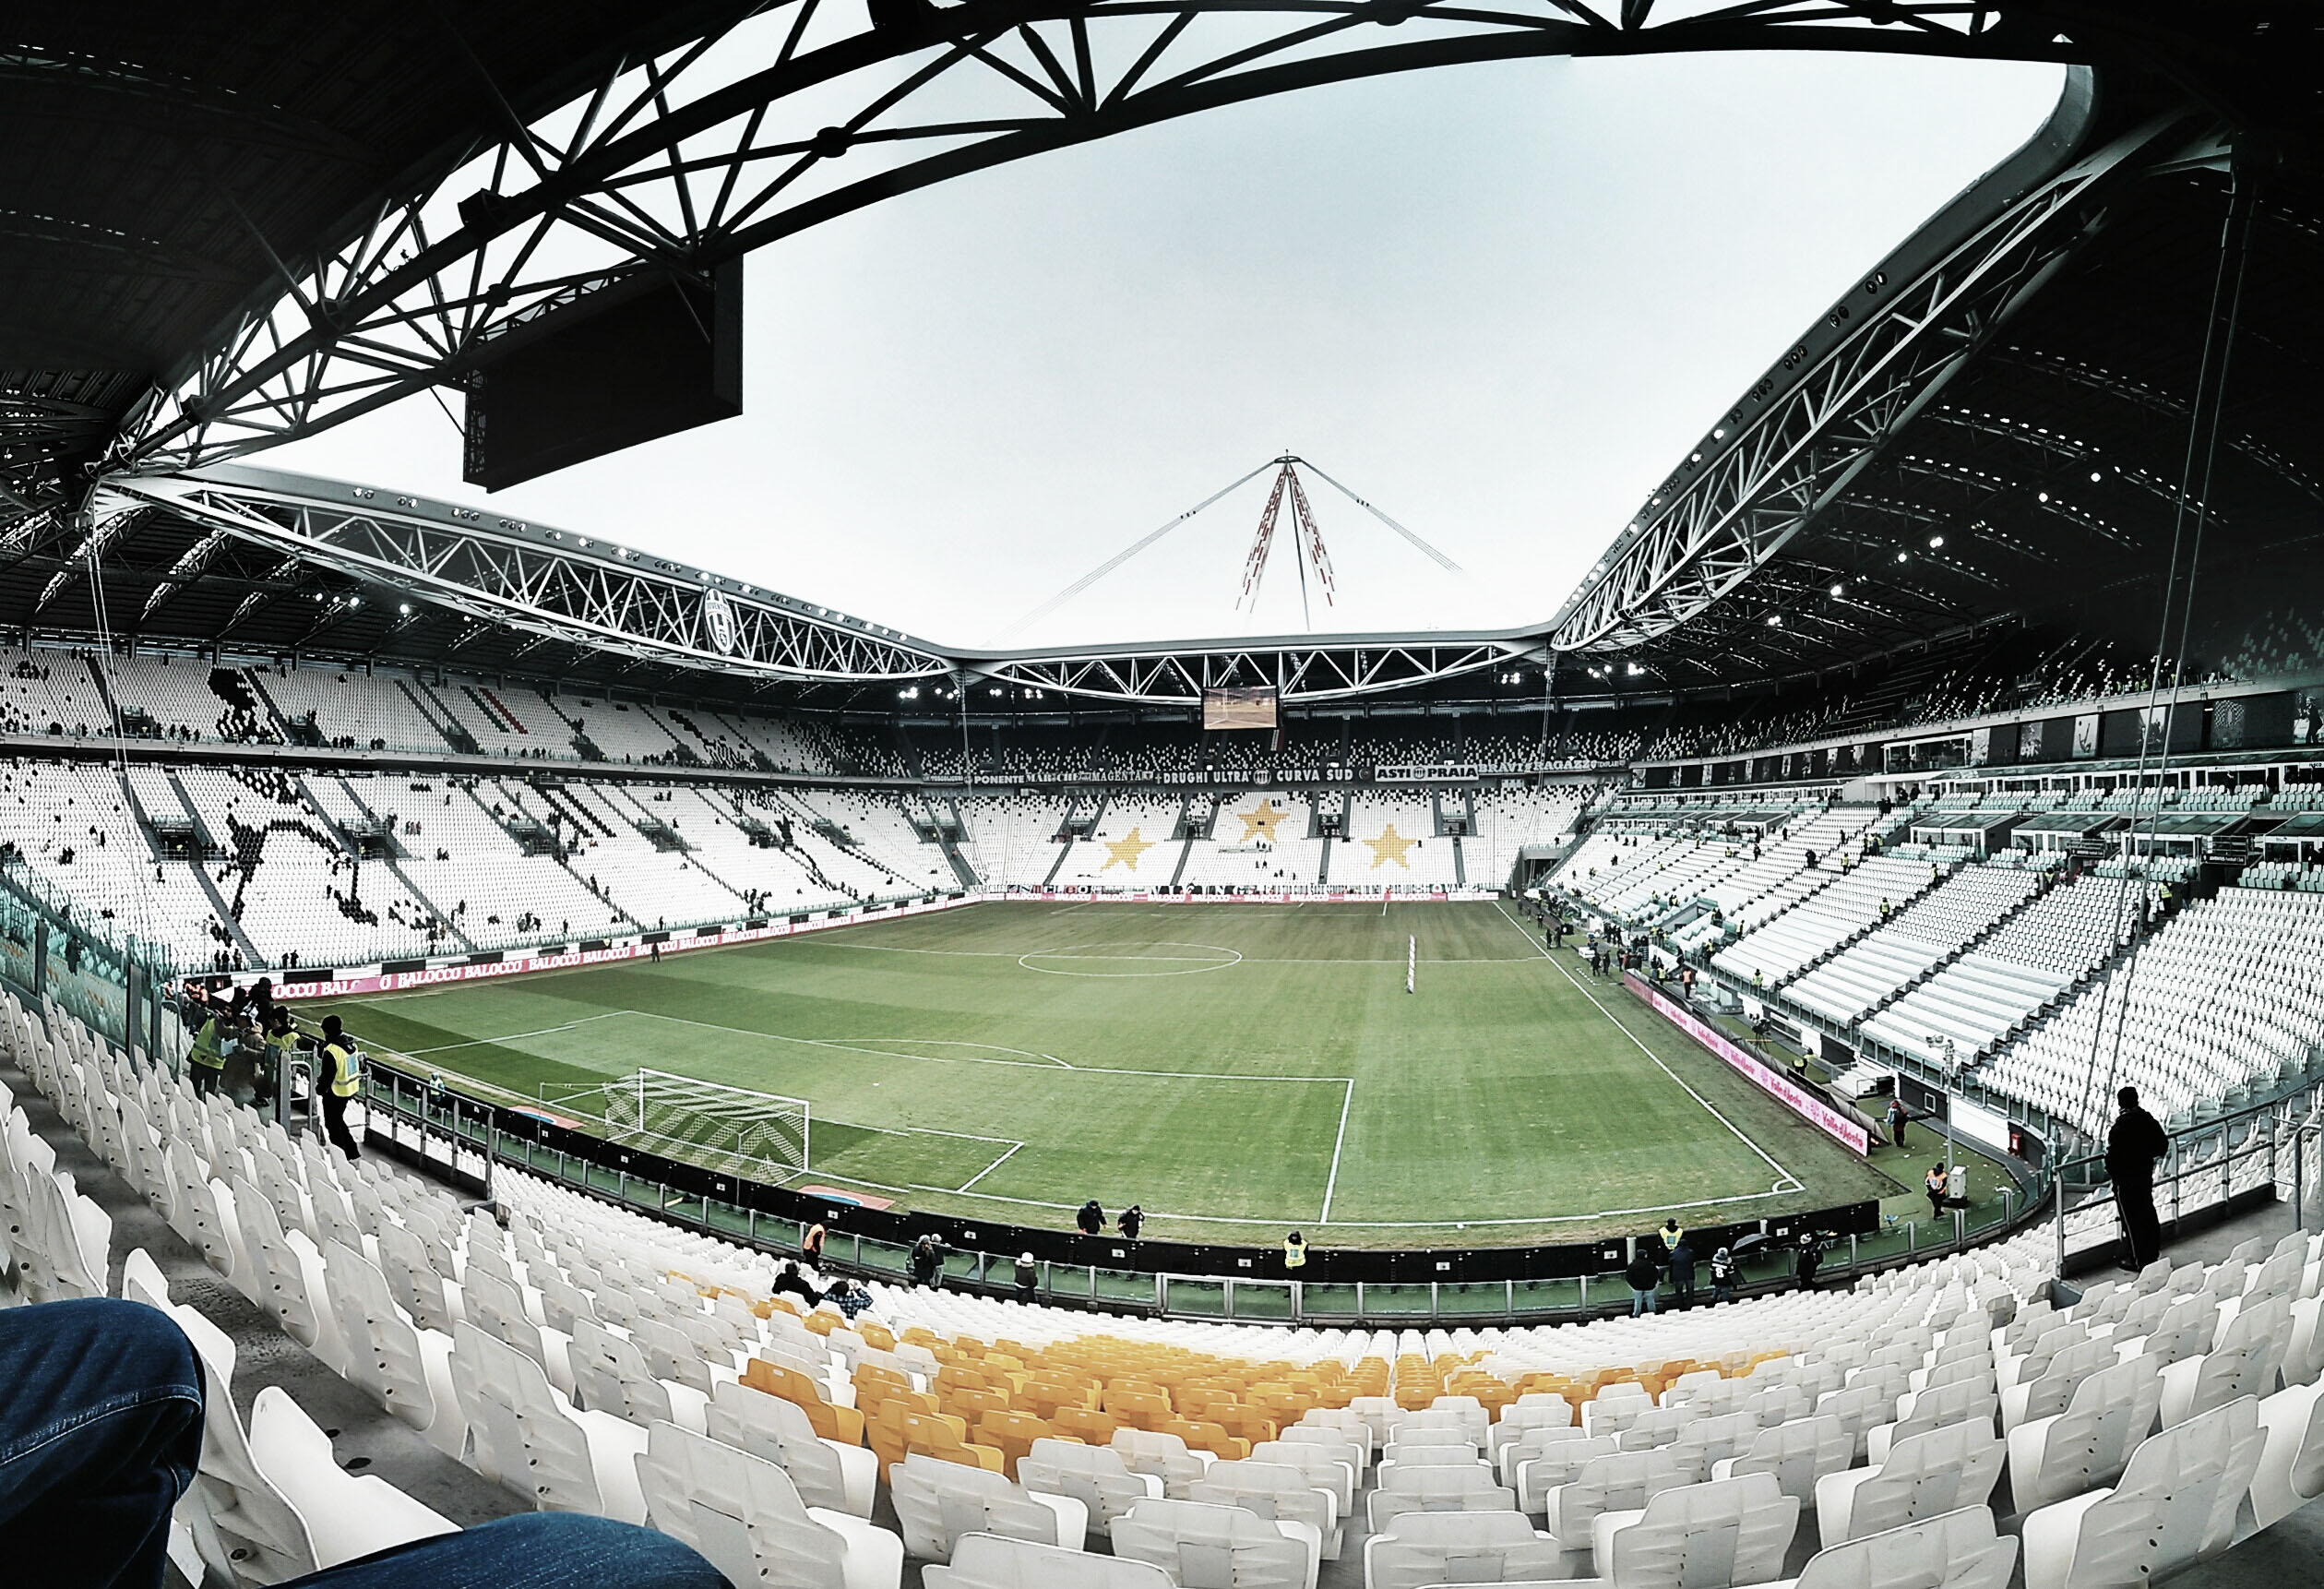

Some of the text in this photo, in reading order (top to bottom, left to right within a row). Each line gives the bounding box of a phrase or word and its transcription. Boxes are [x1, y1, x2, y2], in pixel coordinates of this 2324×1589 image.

[1377, 767, 1477, 779] ASTI PRAIA
[1478, 762, 1522, 773] BRAVI
[973, 775, 1025, 784] PONENTE
[1091, 771, 1143, 782] MAGENTA
[1163, 771, 1208, 784] DRUGHI
[1276, 770, 1320, 782] CURVA
[1326, 769, 1353, 781] SUD
[398, 969, 460, 988] BALOCCO
[464, 960, 523, 979] BALOCCO
[529, 953, 579, 971] BALOCCO
[583, 946, 630, 963] BALOCCO
[635, 938, 679, 956] BALCCO
[678, 934, 718, 950] BALOCCO
[1714, 1267, 1724, 1279] 8
